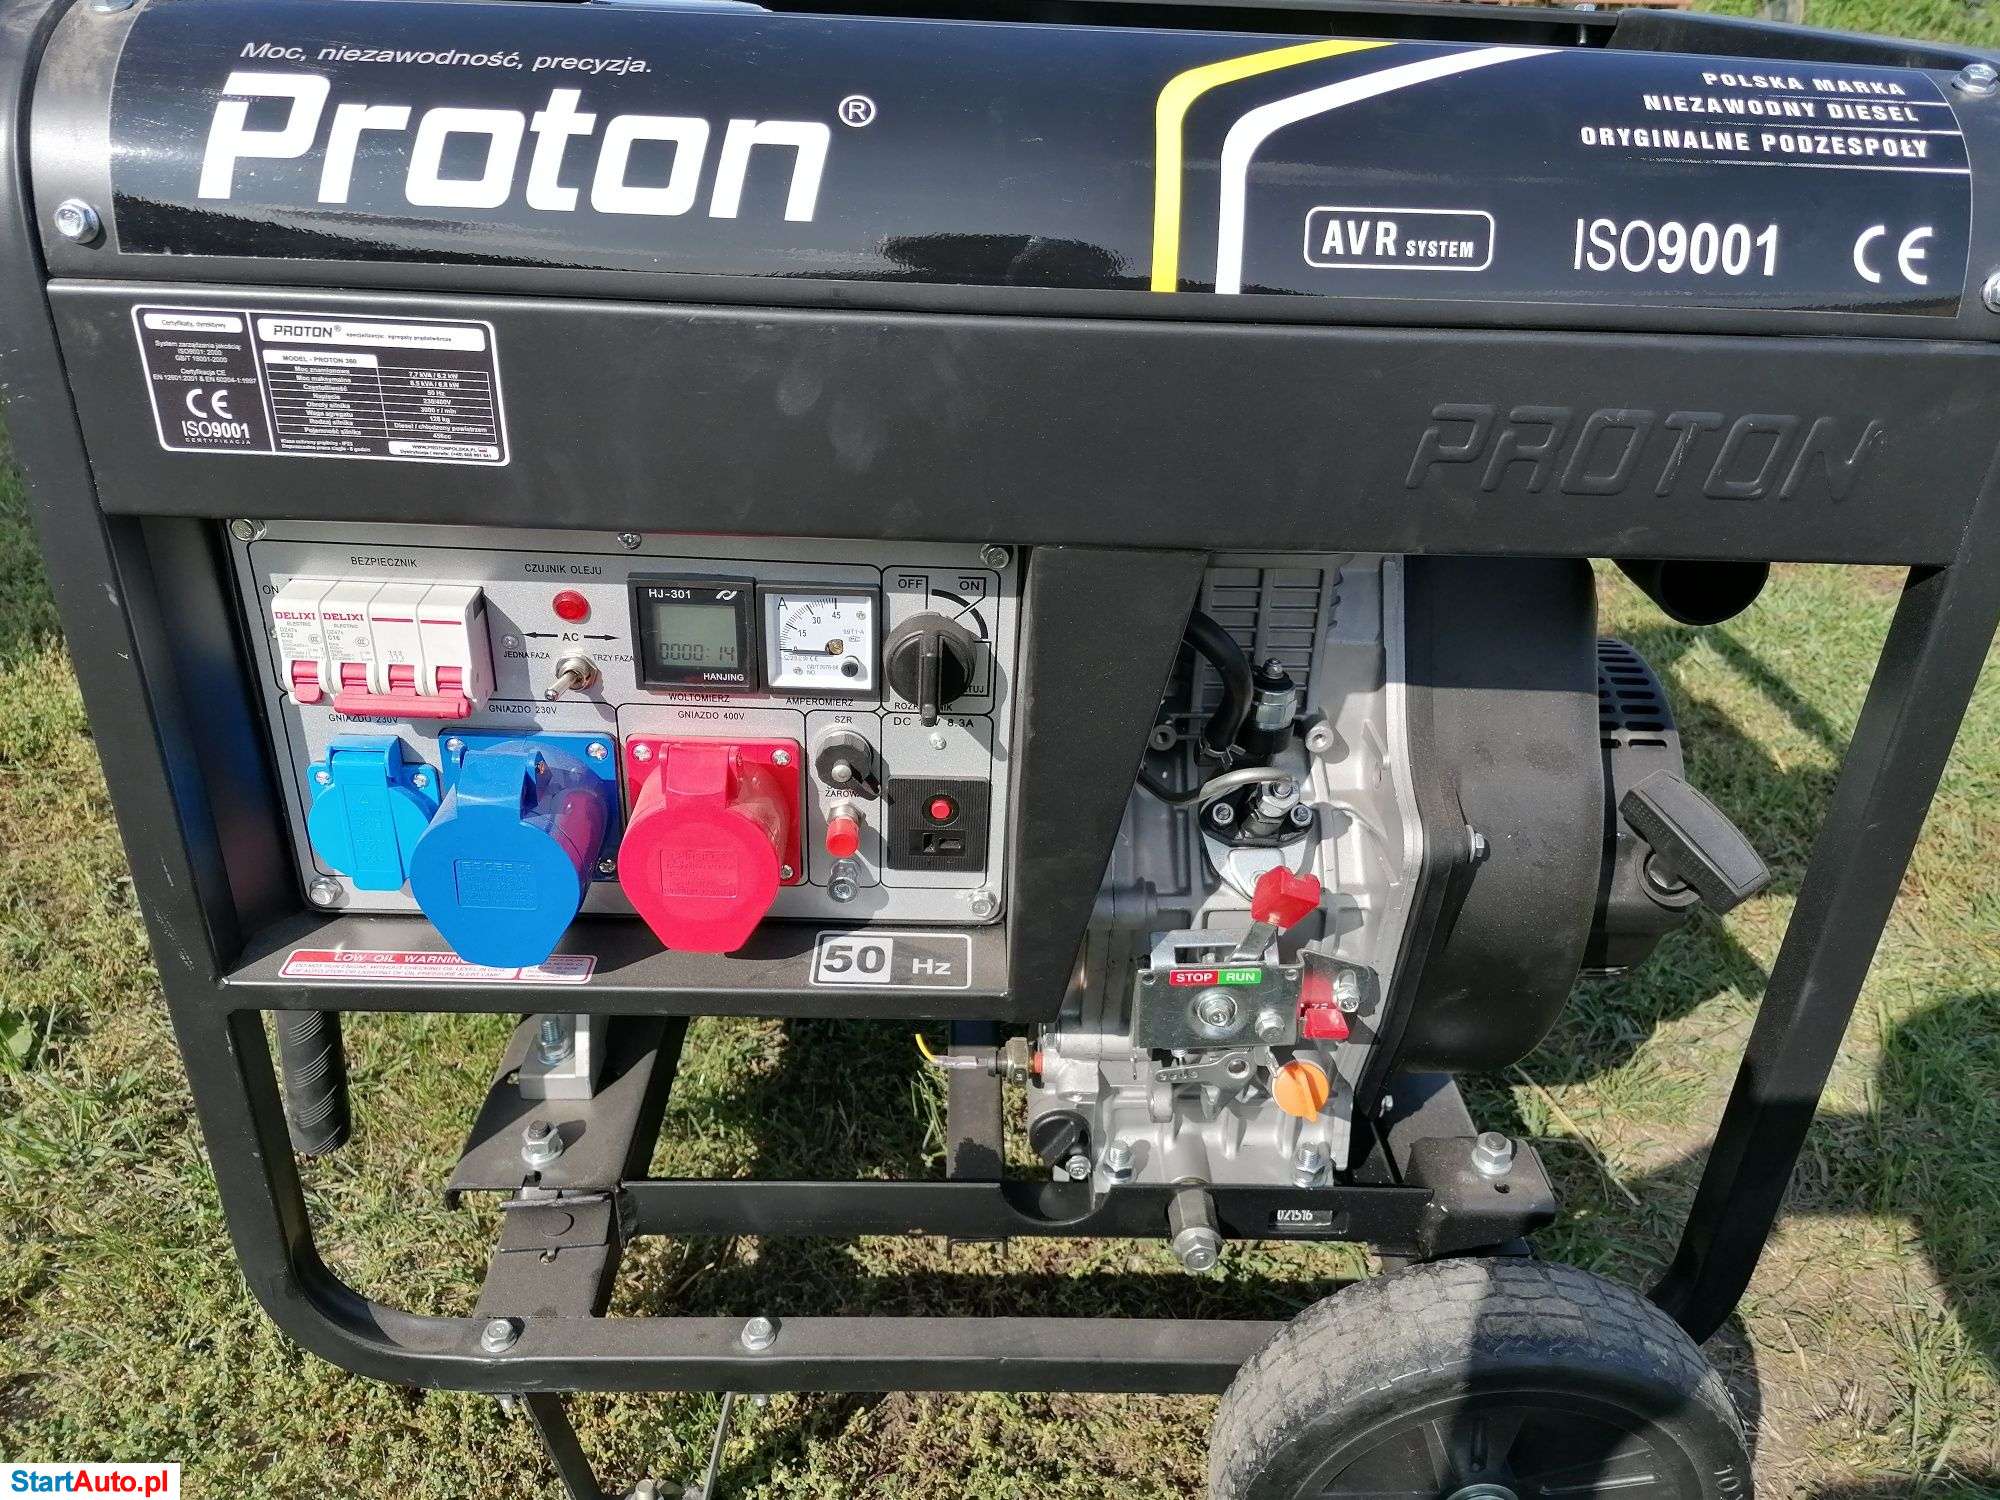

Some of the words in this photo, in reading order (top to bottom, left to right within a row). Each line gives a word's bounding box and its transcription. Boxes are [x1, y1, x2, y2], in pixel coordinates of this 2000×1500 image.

[240, 40, 310, 63] Moc,
[317, 43, 525, 74] niezawodność,
[531, 50, 655, 76] precyzja.
[1701, 71, 1806, 93] POLSKA
[1811, 77, 1907, 97] MARKA
[1642, 94, 1817, 120] NIEZAWODNY
[1827, 100, 1921, 124] DIESEL
[1580, 125, 1751, 153] ORYGINALNE
[1758, 130, 1931, 159] PODZESPOŁY
[1321, 218, 1398, 257] AVR
[1404, 237, 1475, 260] SYSTEM
[1573, 216, 1781, 277] ISO9001
[181, 420, 250, 439] ISO9001
[1405, 402, 1884, 504] PROTON
[350, 556, 418, 568] BEZPIECZNIK
[524, 562, 567, 575] CZUJNIK
[570, 564, 603, 577] OLEJU
[897, 577, 924, 589] OFF
[959, 579, 981, 591] ON
[262, 584, 280, 596] ON
[648, 588, 692, 600] HJ-301
[777, 596, 788, 611] A
[274, 611, 316, 621] DELIXI
[322, 612, 364, 622] DELIXI
[812, 616, 822, 625] 30
[831, 611, 841, 620] 45
[562, 632, 579, 642] AC
[798, 629, 807, 638] 15
[503, 650, 529, 659] JEDNA
[529, 651, 551, 660] FAZA
[592, 653, 613, 662] TRZY
[614, 654, 634, 663] FAZA
[703, 672, 745, 682] HANJING
[668, 692, 731, 703] WOLTOMIERZ
[785, 696, 855, 708] AMPEROMIERZ
[488, 703, 532, 715] GNIAZDO
[535, 705, 558, 716] 230V
[677, 710, 719, 720] GNIAZDO
[723, 711, 745, 721] 400V
[328, 712, 372, 724] GNIAZDO
[375, 714, 399, 725] 230V
[834, 715, 853, 725] SZR
[893, 716, 911, 726] DC
[947, 718, 974, 728] 8.3A
[334, 951, 367, 962] LOW
[374, 952, 396, 963] OIL
[404, 953, 465, 965] WARNIN
[822, 944, 887, 974] 50
[911, 957, 952, 976] Hz
[1176, 973, 1213, 983] STOP
[1225, 972, 1256, 982] RUN
